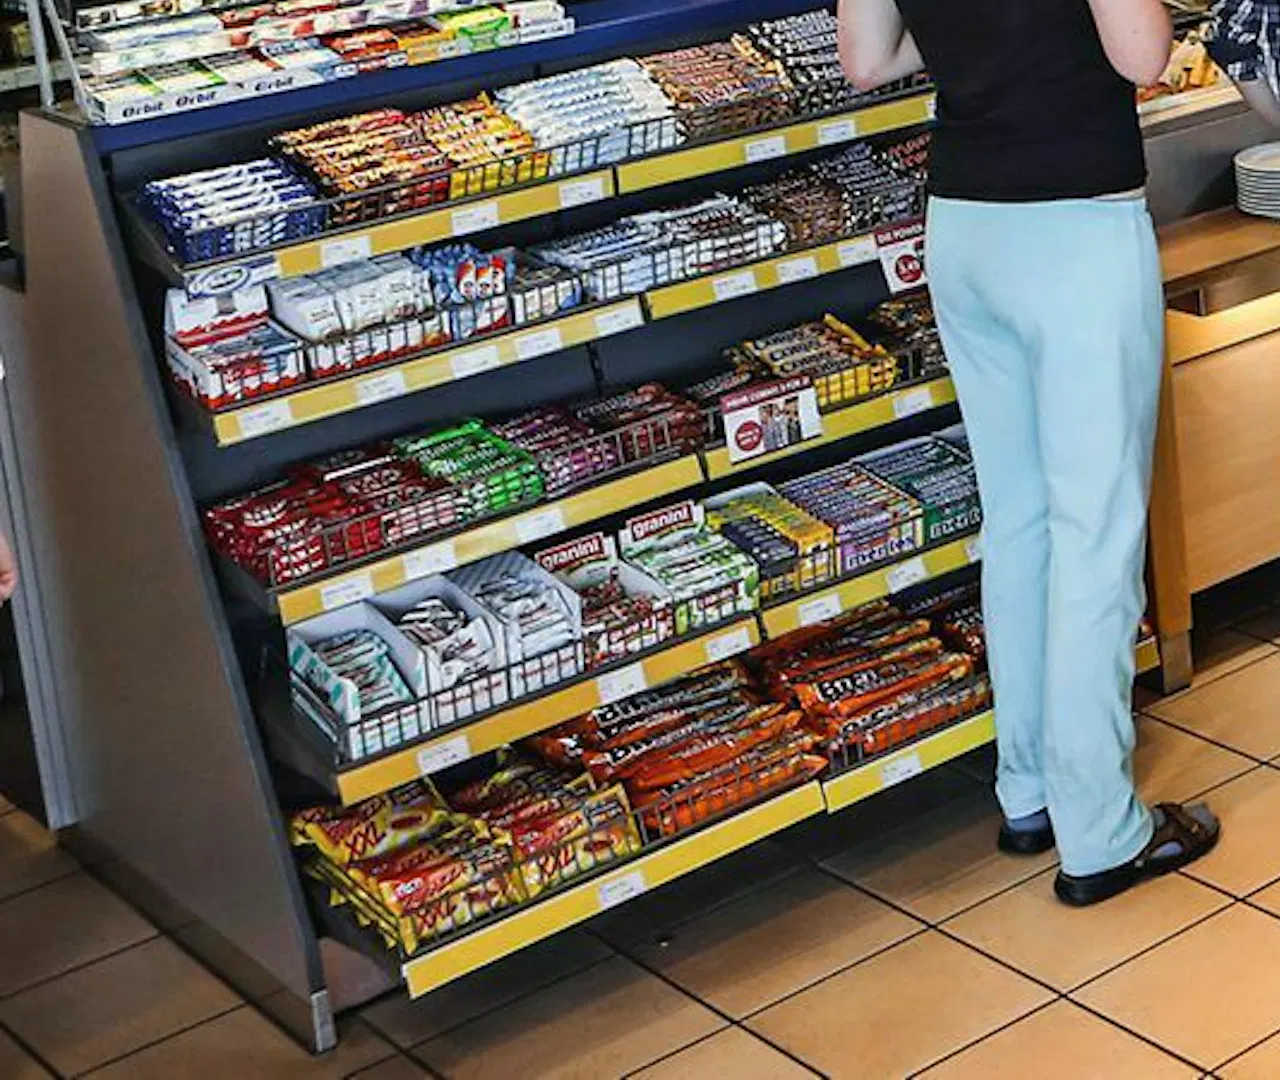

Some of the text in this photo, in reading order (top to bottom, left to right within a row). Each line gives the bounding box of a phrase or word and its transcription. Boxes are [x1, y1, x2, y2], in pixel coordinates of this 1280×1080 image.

[254, 76, 294, 93] Orbit
[175, 90, 216, 108] Orbit
[122, 100, 164, 119] Orbit
[633, 505, 691, 538] granini
[541, 537, 601, 570] granini
